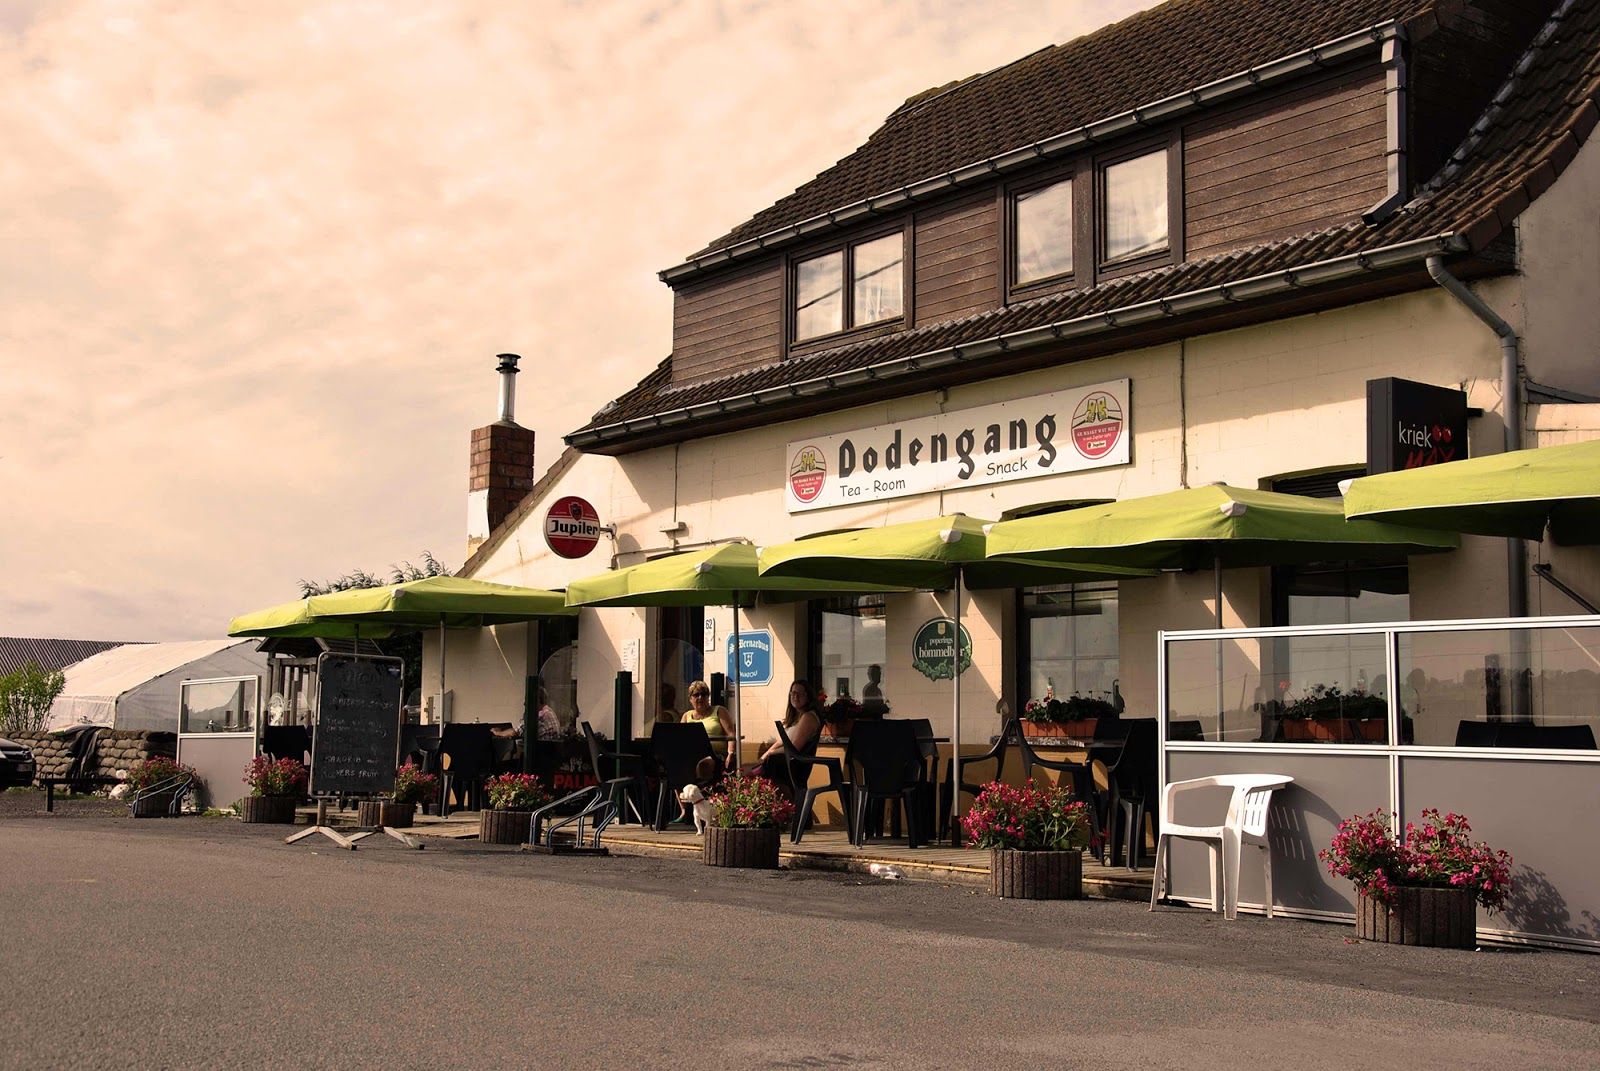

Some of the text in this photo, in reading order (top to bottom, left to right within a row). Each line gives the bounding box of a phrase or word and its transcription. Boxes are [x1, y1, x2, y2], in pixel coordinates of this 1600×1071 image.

[1399, 420, 1432, 448] kriek
[839, 413, 1057, 480] Dodengang
[986, 457, 1028, 476] Snack
[840, 484, 861, 497] Tea
[873, 479, 906, 492] Room
[550, 519, 598, 536] Jupiler
[918, 645, 965, 658] hommelbr
